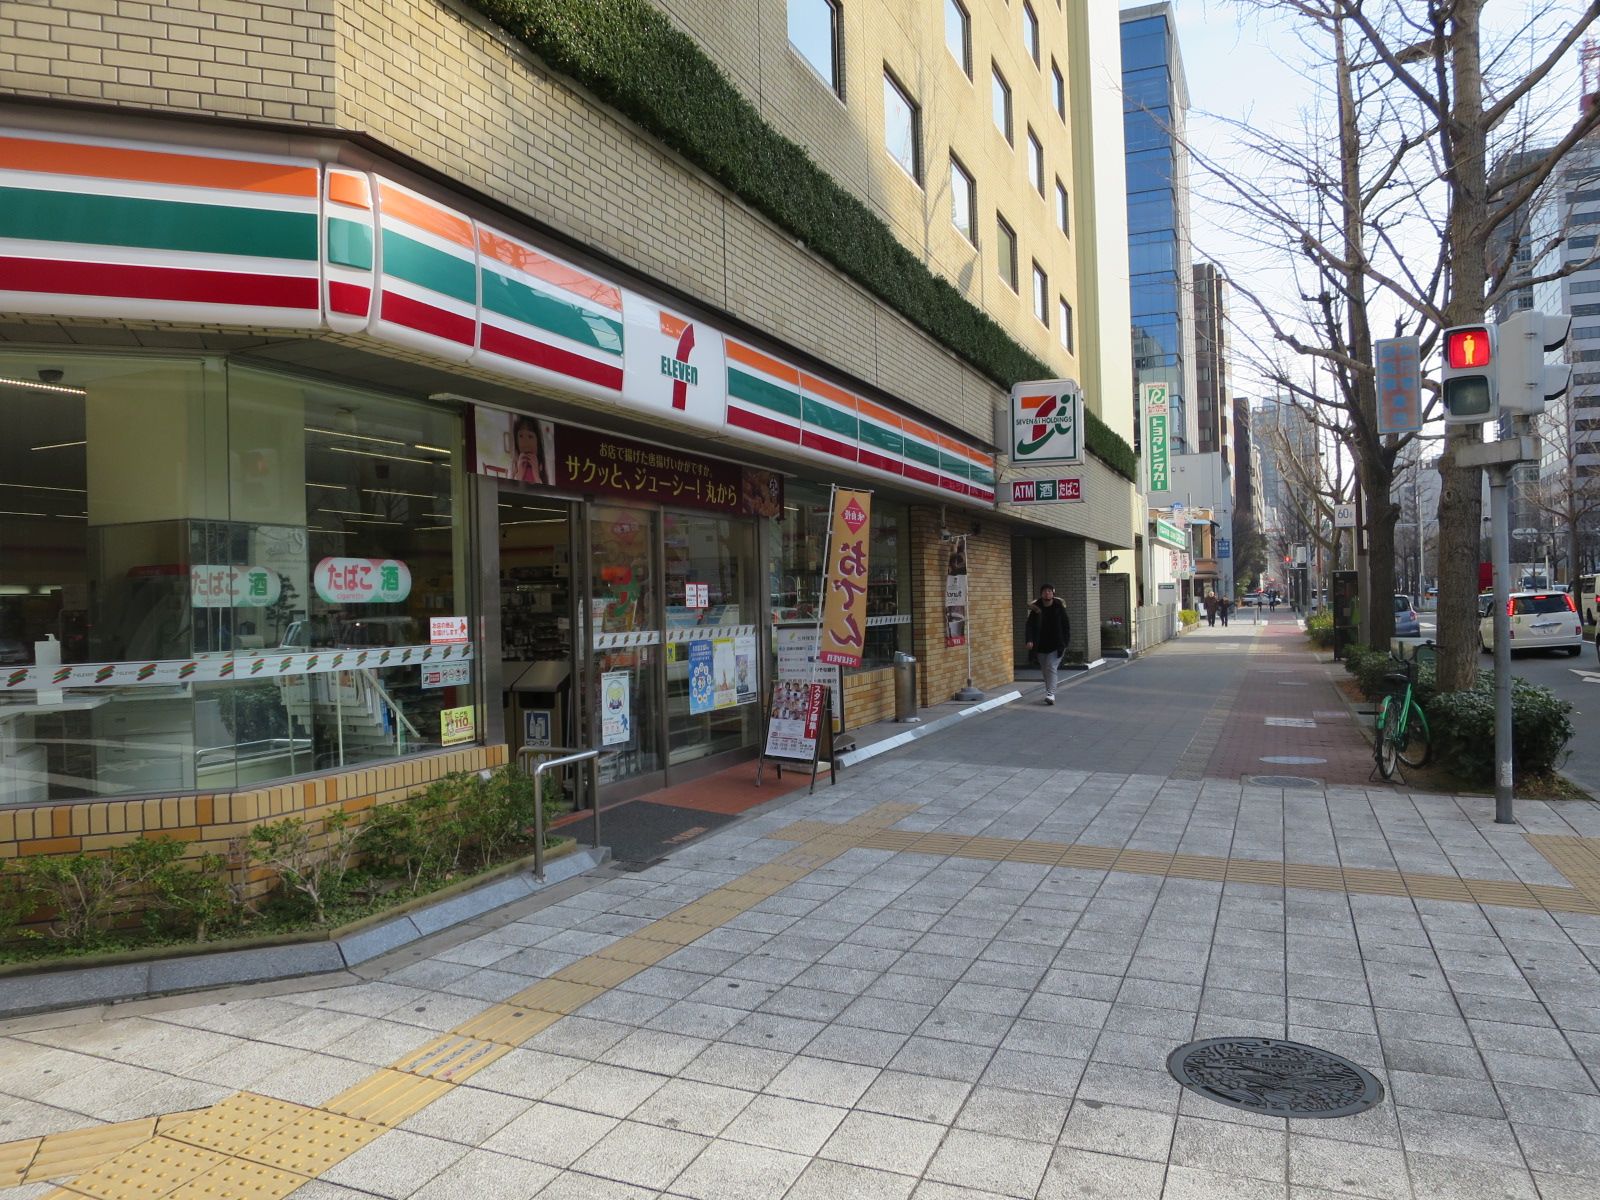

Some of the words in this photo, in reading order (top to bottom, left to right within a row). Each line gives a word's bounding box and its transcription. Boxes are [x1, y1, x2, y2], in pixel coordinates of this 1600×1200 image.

[661, 355, 698, 386] ELEVEN
[1042, 416, 1072, 424] HOLDINGS
[1152, 418, 1165, 490] トヨタレンタカー
[706, 480, 737, 507] 丸から
[1015, 484, 1034, 498] ATM
[1040, 483, 1053, 498] 酒
[1059, 481, 1079, 497] たばこ
[249, 573, 268, 597] 酒
[327, 564, 373, 591] たばこ
[380, 566, 399, 591] 酒
